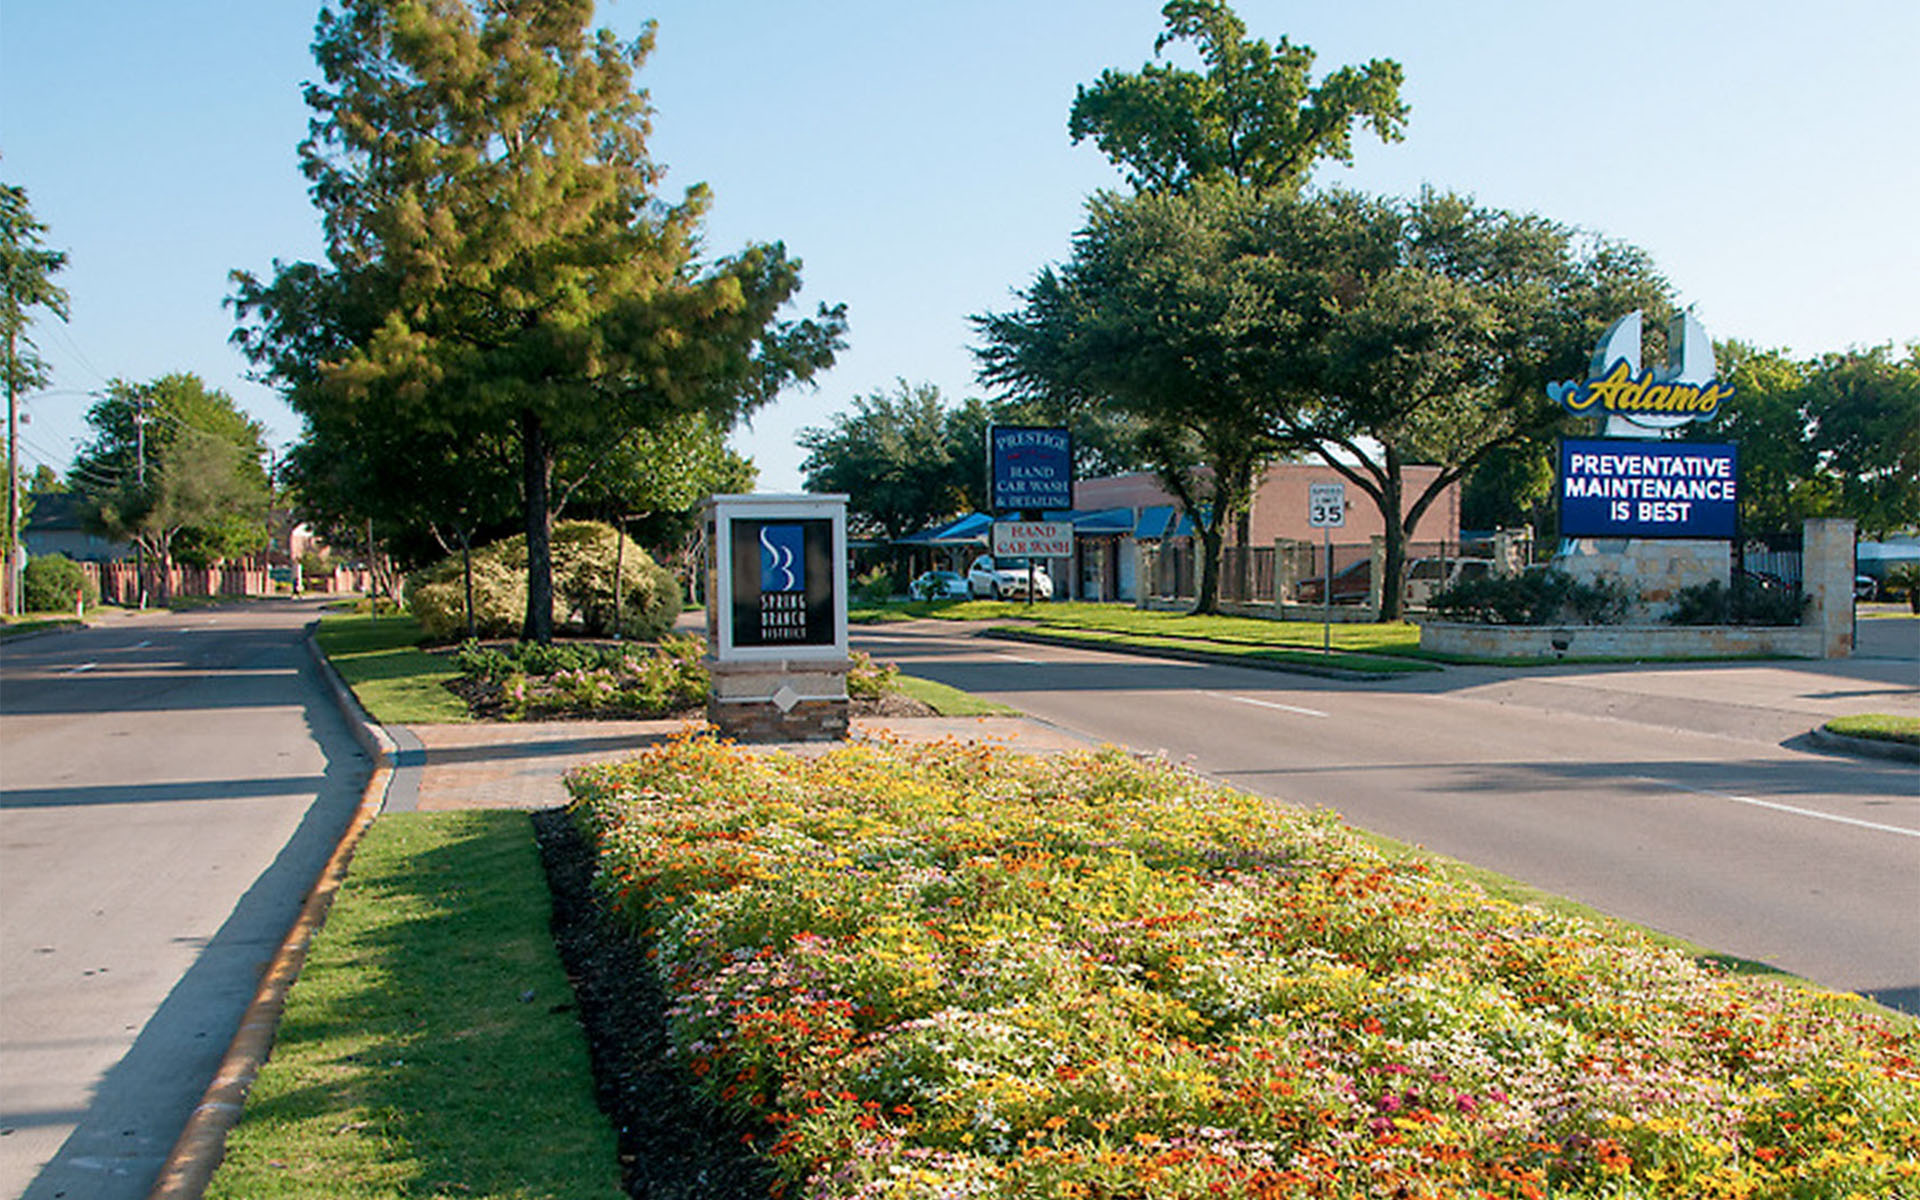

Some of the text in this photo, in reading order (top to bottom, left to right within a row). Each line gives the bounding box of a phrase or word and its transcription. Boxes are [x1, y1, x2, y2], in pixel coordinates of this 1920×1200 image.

[1568, 361, 1735, 411] Adams
[996, 432, 1068, 451] PRESTIGE
[1010, 466, 1054, 478] HAND
[1570, 454, 1731, 477] PREVENTATIVE
[996, 480, 1068, 493] CAR WASH
[1565, 478, 1736, 500] MAINTENANCE
[1009, 496, 1068, 507] DETAILING
[1313, 505, 1341, 522] 35
[1611, 501, 1692, 522] IS BEST
[1011, 526, 1056, 538] HAND
[996, 541, 1070, 553] CAR WASH
[760, 594, 807, 610] SPRING
[760, 611, 807, 627] BRANCH
